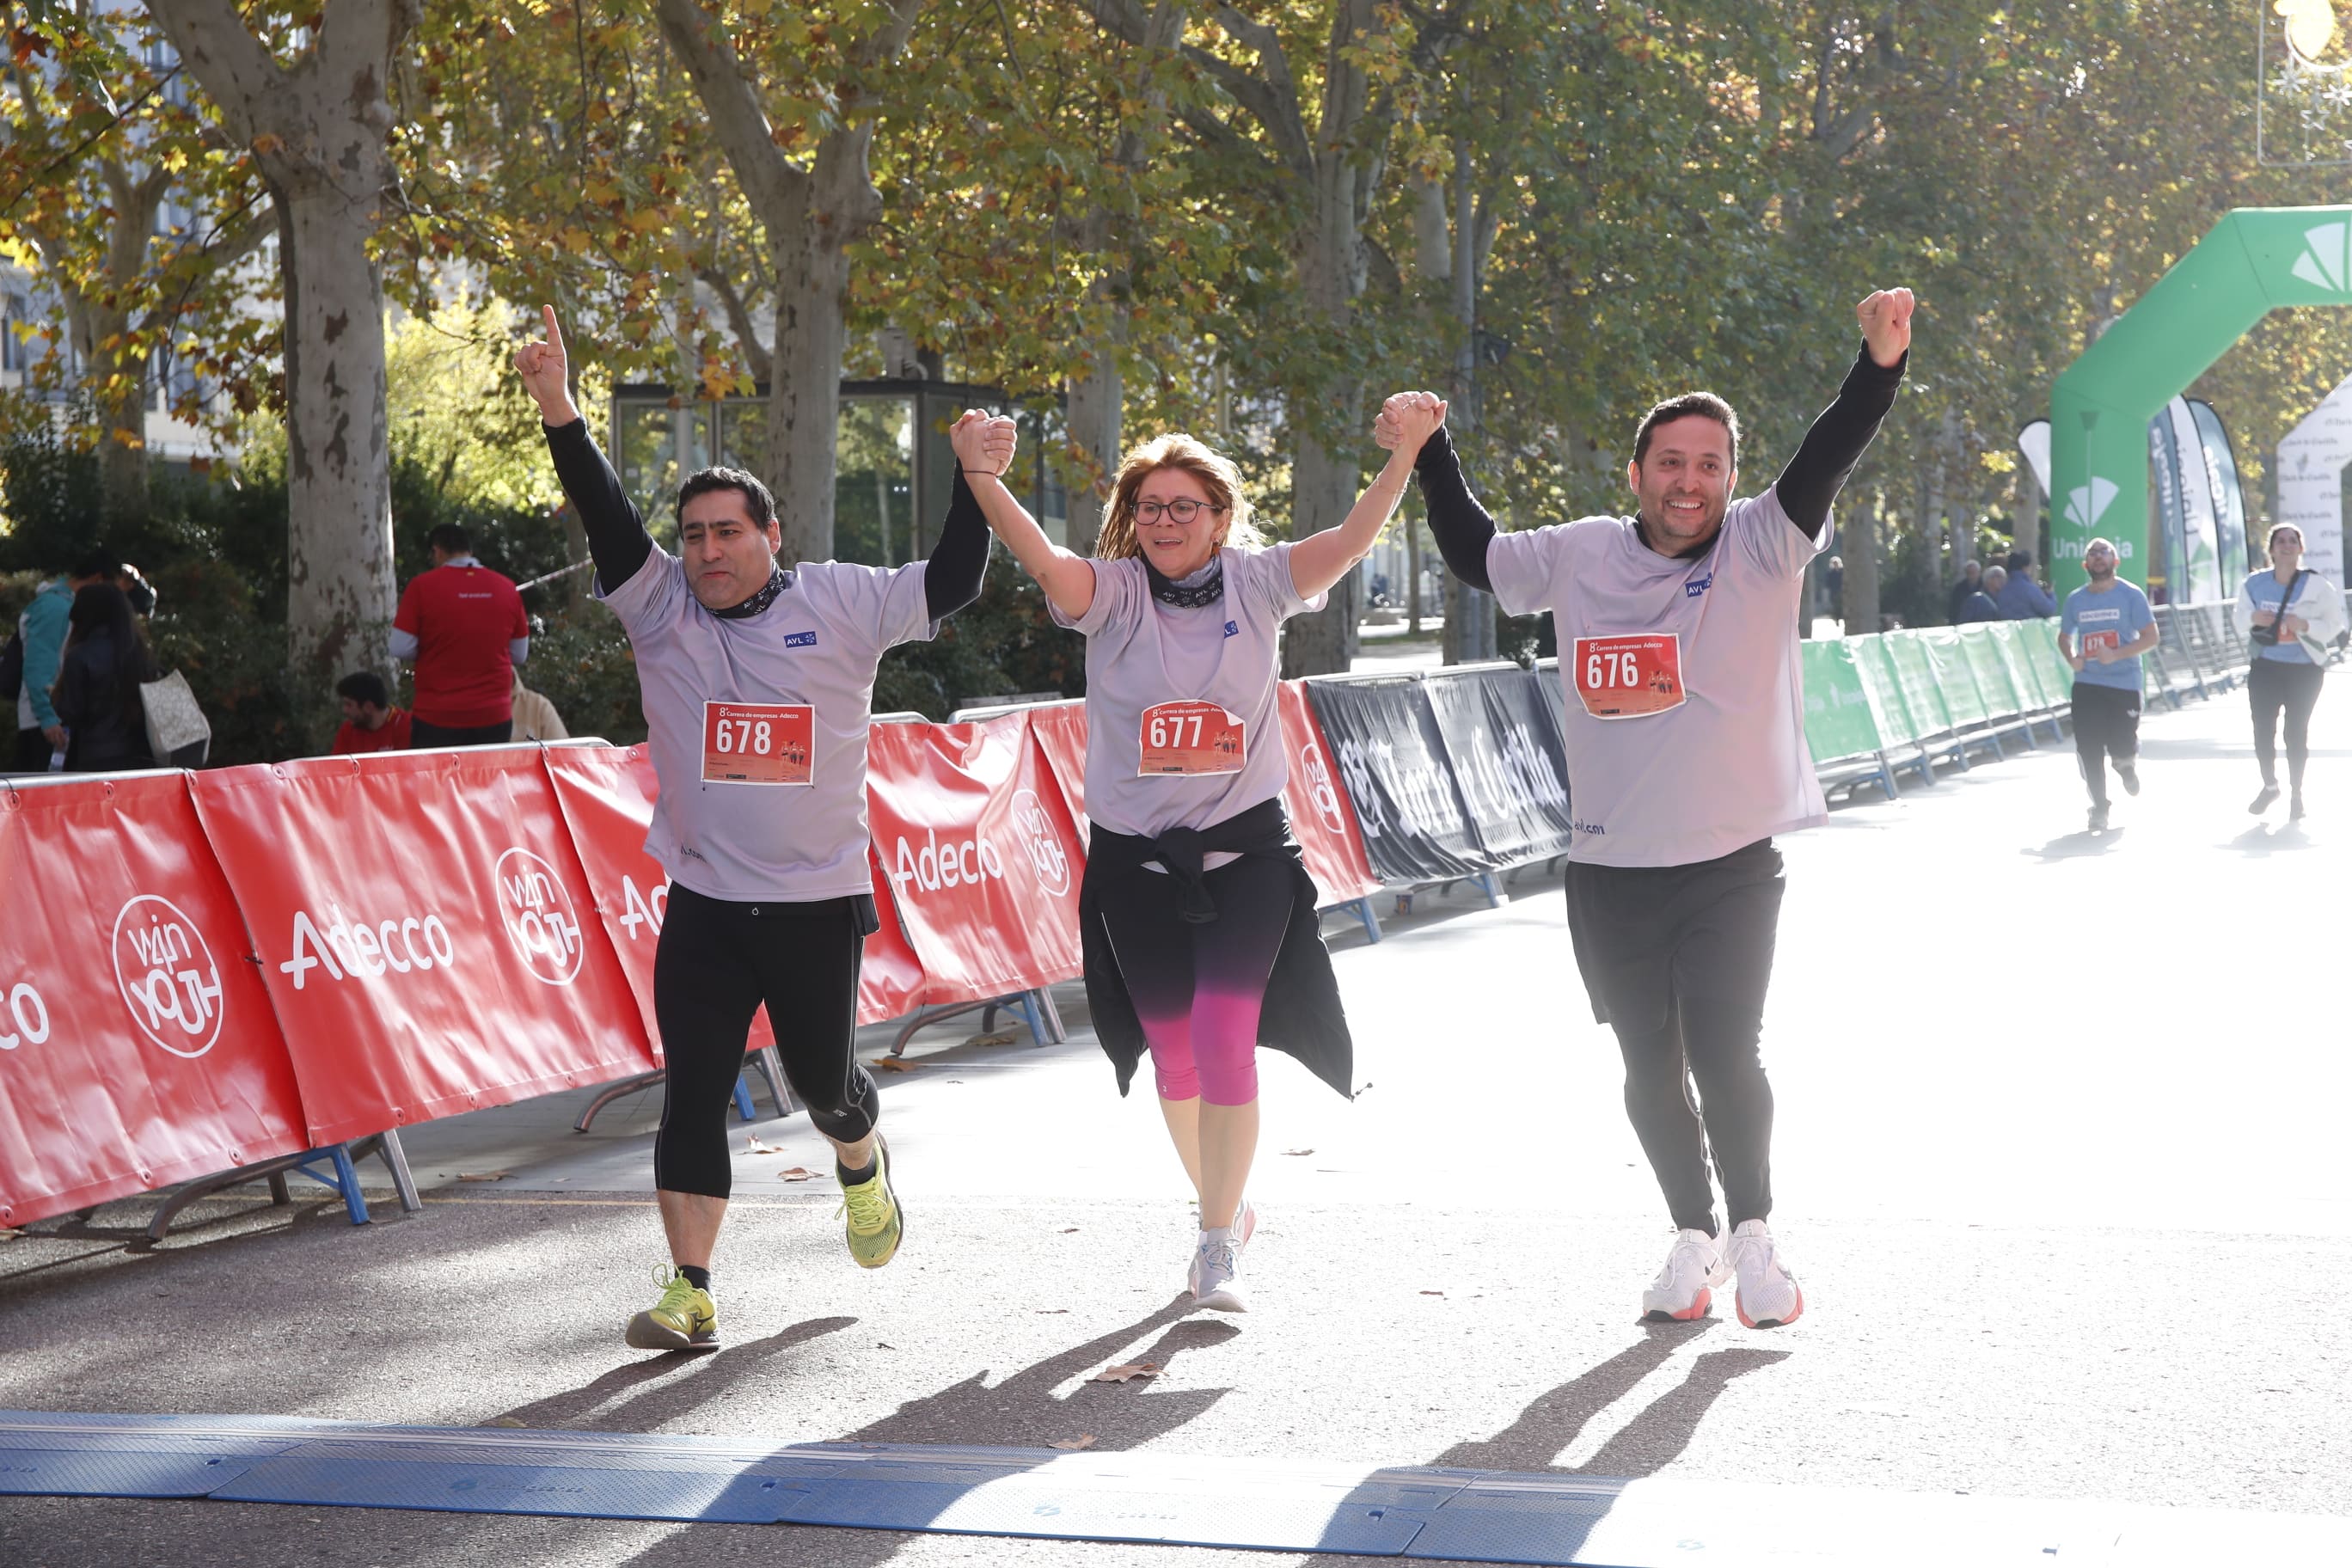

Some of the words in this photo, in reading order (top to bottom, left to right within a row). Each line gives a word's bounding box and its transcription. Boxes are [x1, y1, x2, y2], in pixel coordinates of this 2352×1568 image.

[787, 637, 804, 646] AVL
[1587, 652, 1639, 689] 676
[716, 719, 771, 755] 678
[1150, 715, 1203, 748] 677
[279, 903, 454, 990] Adecco
